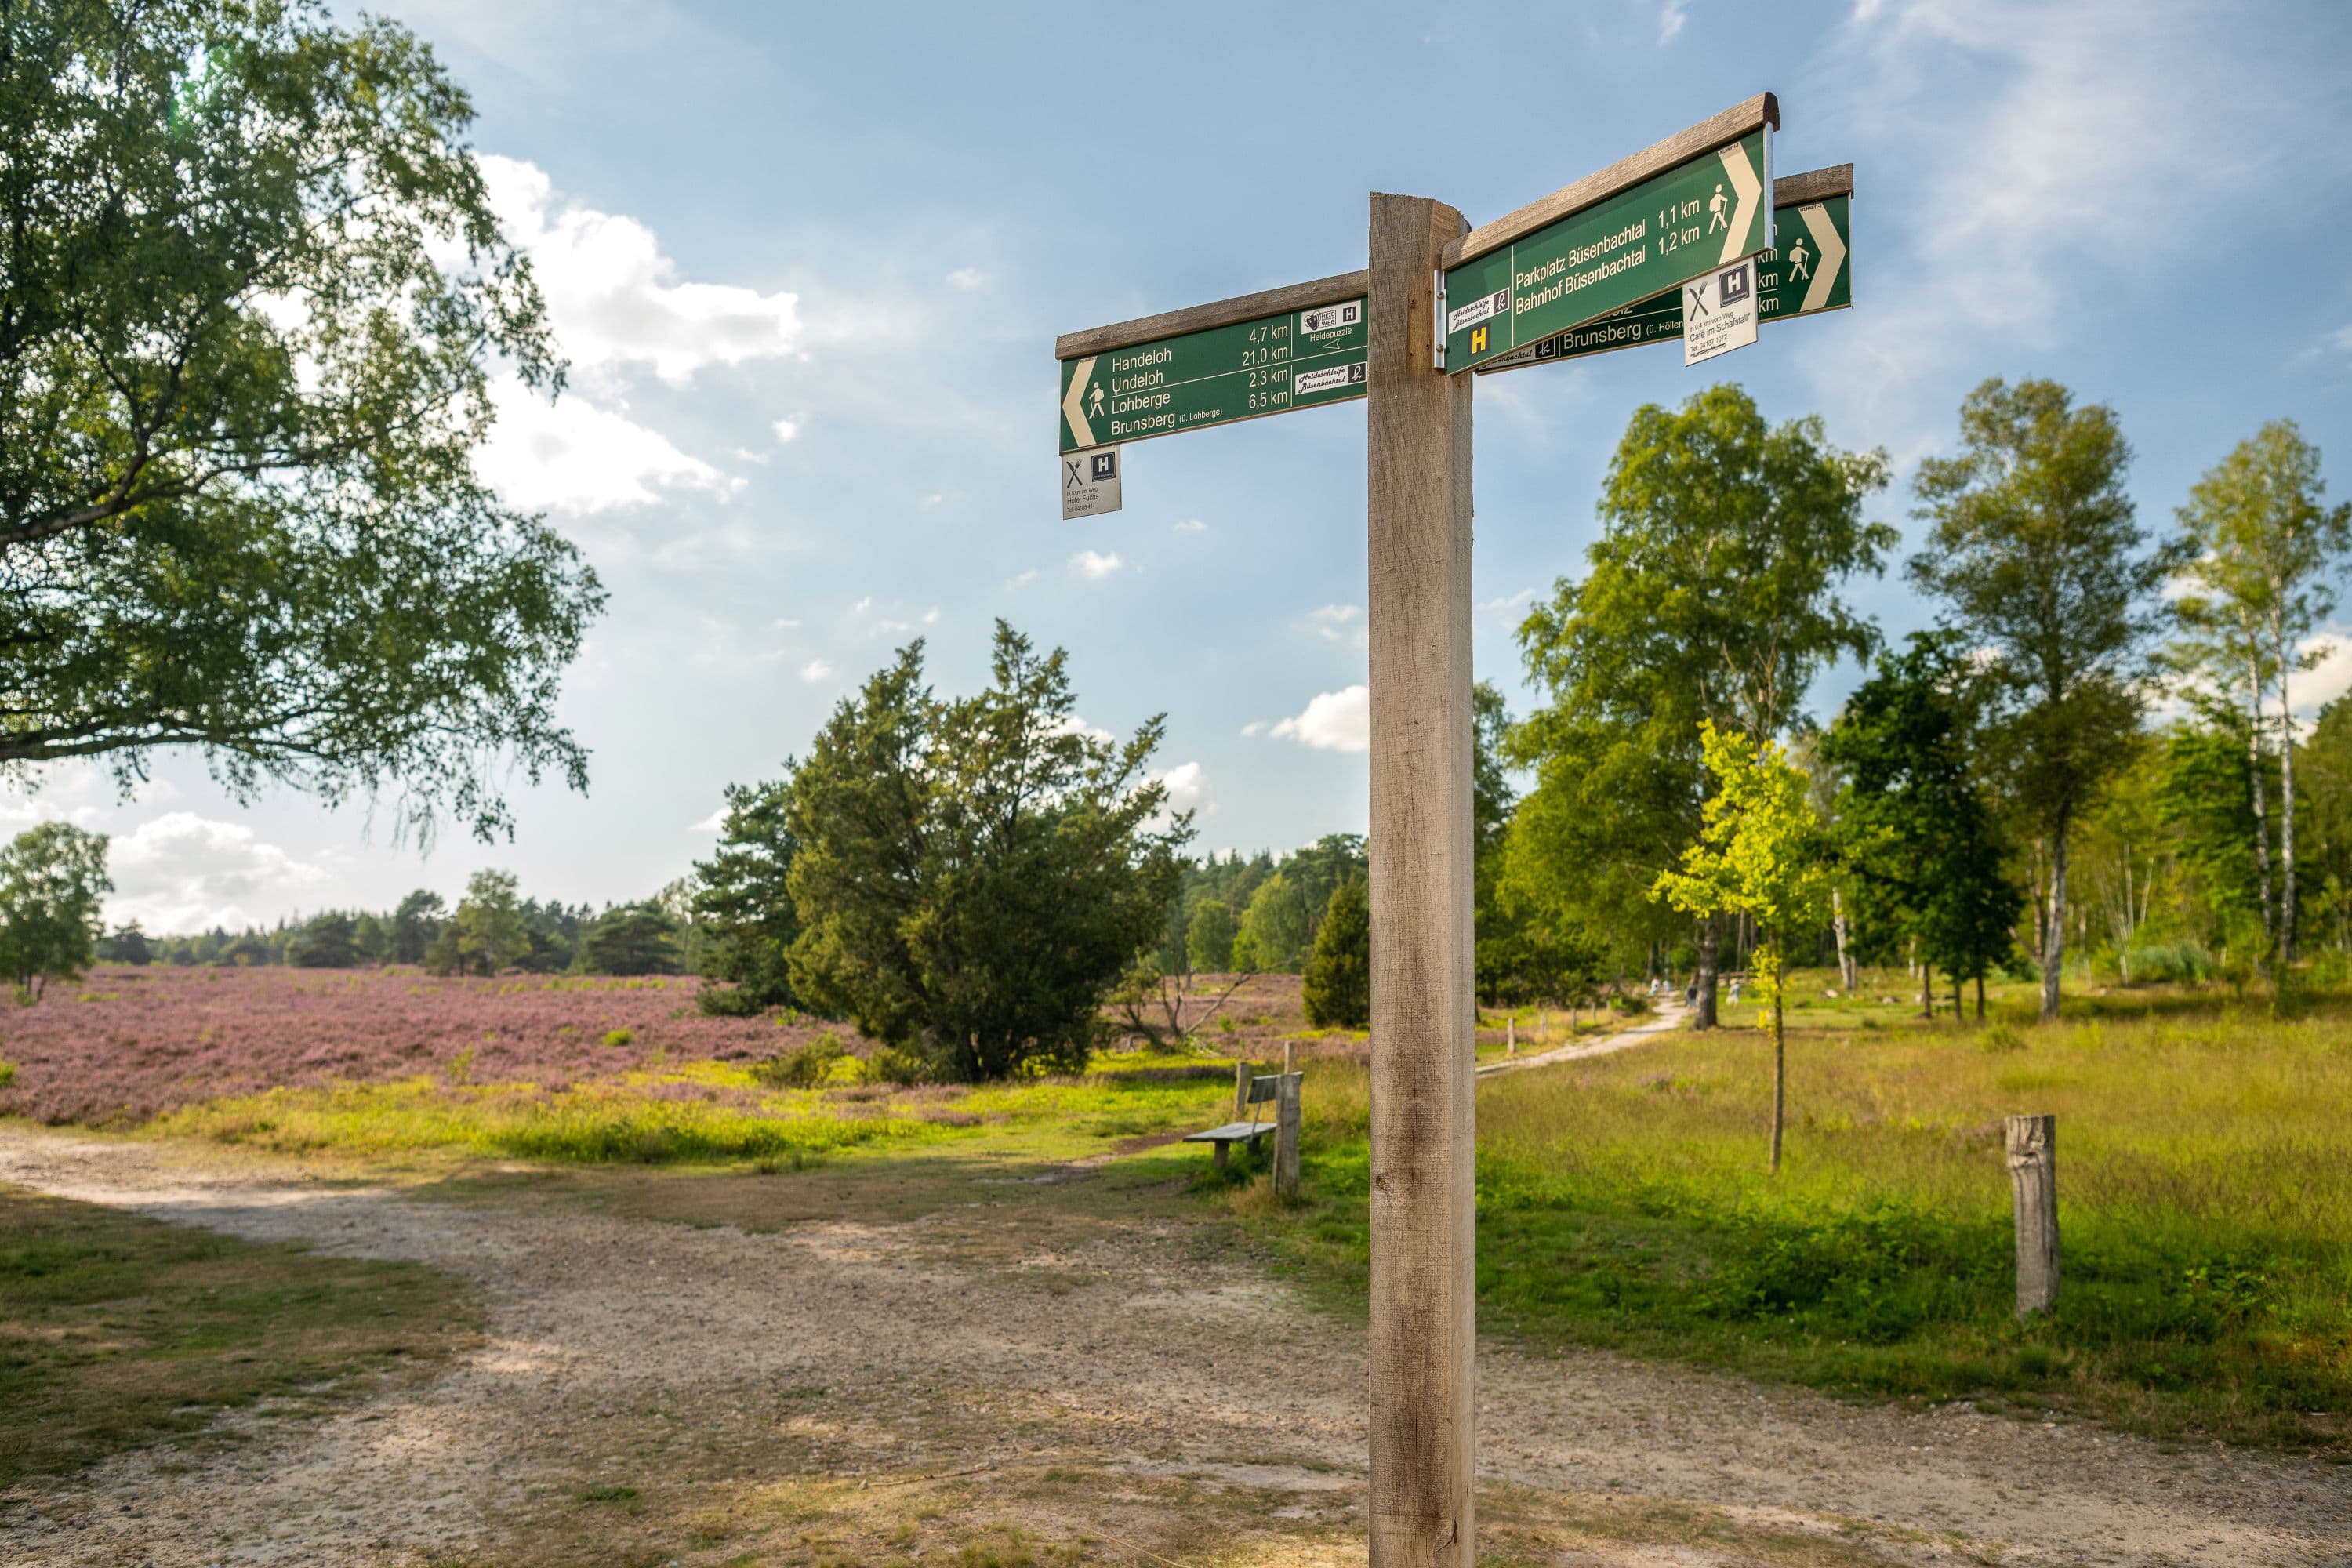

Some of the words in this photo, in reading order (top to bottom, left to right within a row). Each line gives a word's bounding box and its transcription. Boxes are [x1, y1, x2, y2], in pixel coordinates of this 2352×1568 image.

[1516, 256, 1566, 290] Parkplatz
[1568, 219, 1646, 268] Büsenbachtal
[1659, 205, 1675, 229] 1,1
[1681, 200, 1699, 220] km
[1516, 279, 1563, 315] Bahnhof
[1565, 245, 1646, 295] Büsenbachtal
[1659, 232, 1677, 256] 1,2
[1681, 226, 1699, 246] km
[1758, 272, 1778, 288] km
[1728, 272, 1741, 294] H
[1346, 308, 1353, 320] H
[1453, 298, 1489, 320] Heideschleife
[1453, 307, 1489, 331] Büsenbachtal
[1564, 323, 1641, 349] Brunsberg
[1647, 325, 1656, 336] (ü.
[1759, 297, 1779, 313] km
[1310, 327, 1352, 342] Heidepuzzle
[1472, 326, 1486, 354] H
[1690, 329, 1705, 342] Café
[1707, 328, 1715, 336] im
[1112, 347, 1171, 372] Handeloh
[1249, 327, 1267, 345] 4,7
[1271, 325, 1288, 340] km
[1112, 370, 1163, 392] Undeloh
[1242, 348, 1267, 366] 21,0
[1271, 346, 1288, 361] km
[1299, 367, 1345, 383] Heideschleife
[1112, 393, 1170, 415] Lohberge
[1249, 370, 1267, 389] 2,3
[1271, 369, 1288, 383] km
[1298, 375, 1345, 393] Büsenbachtal
[1112, 413, 1175, 435] Brunsberg
[1179, 414, 1188, 424] (ü.
[1190, 408, 1223, 421] Lohberge)
[1249, 392, 1267, 410] 6,5
[1271, 390, 1288, 405] km
[1099, 457, 1109, 472] H
[1067, 496, 1081, 505] Hotel
